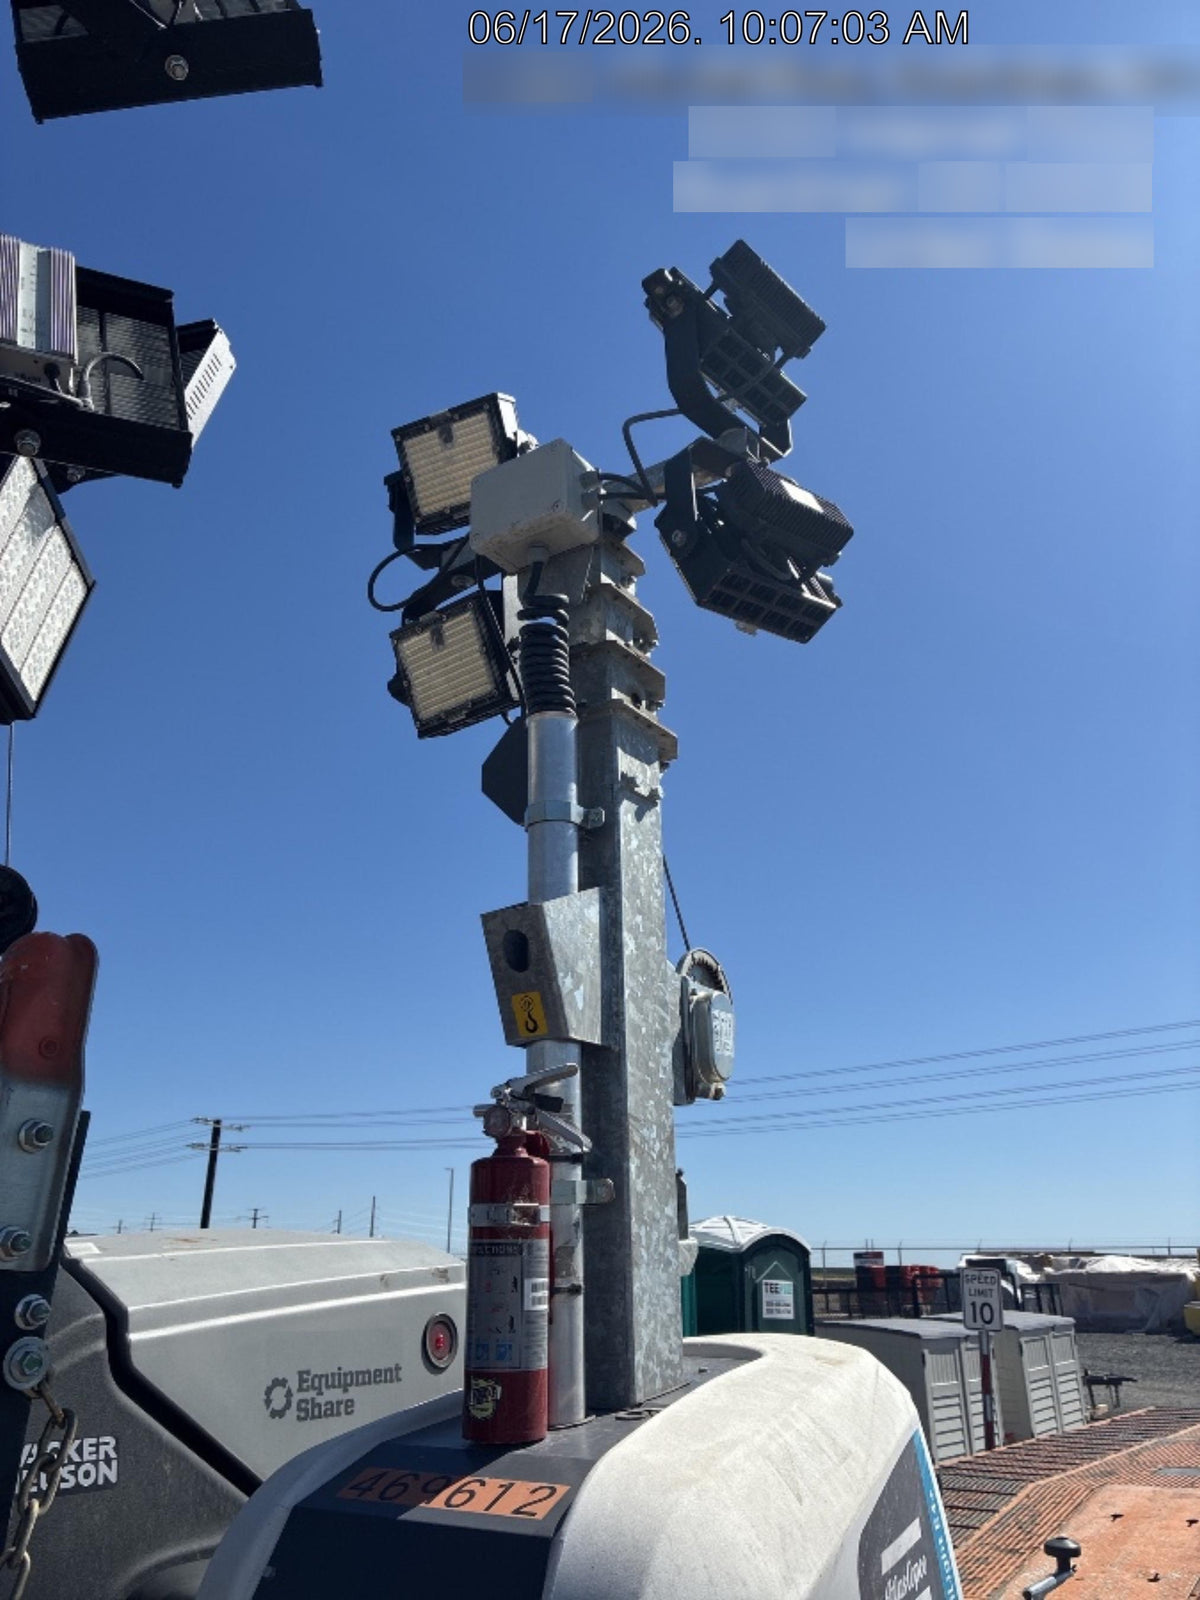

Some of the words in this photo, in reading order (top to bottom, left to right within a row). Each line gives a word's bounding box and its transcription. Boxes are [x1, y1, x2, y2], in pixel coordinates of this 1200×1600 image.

[965, 1274, 997, 1285] SPEED
[968, 1288, 993, 1298] LIMIT
[970, 1301, 994, 1325] 10
[296, 1363, 402, 1396] Equipment
[296, 1398, 355, 1422] Share
[19, 1436, 118, 1468] AKER
[15, 1459, 118, 1494] SON
[350, 1470, 557, 1517] 469612
